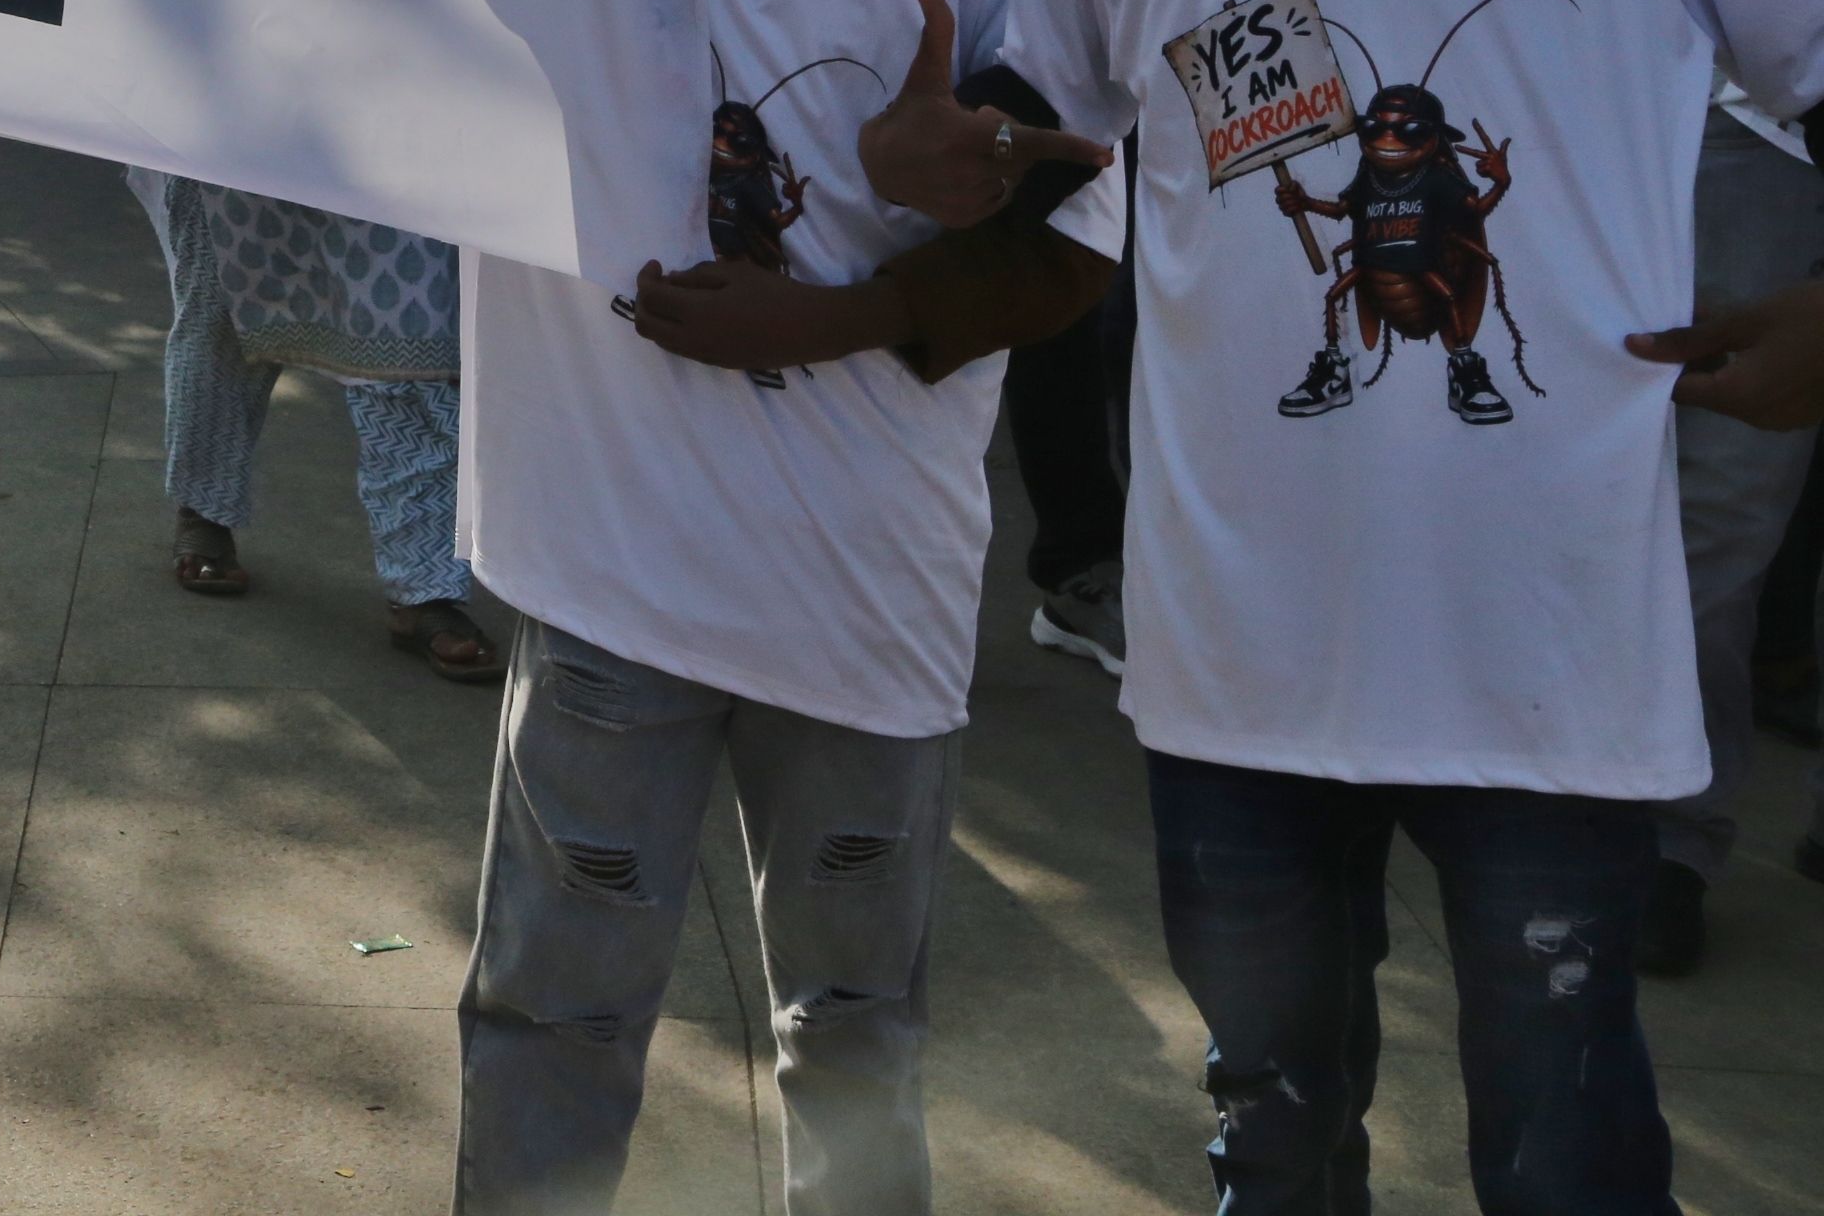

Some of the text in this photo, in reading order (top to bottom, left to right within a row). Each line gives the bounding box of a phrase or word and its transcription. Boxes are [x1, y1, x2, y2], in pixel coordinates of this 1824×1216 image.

[1195, 4, 1283, 91] YES
[1221, 59, 1298, 119] I AM
[1207, 77, 1344, 171] COCKROACH
[1366, 200, 1424, 218] NOT A BUG.
[1383, 218, 1420, 239] VIBE
